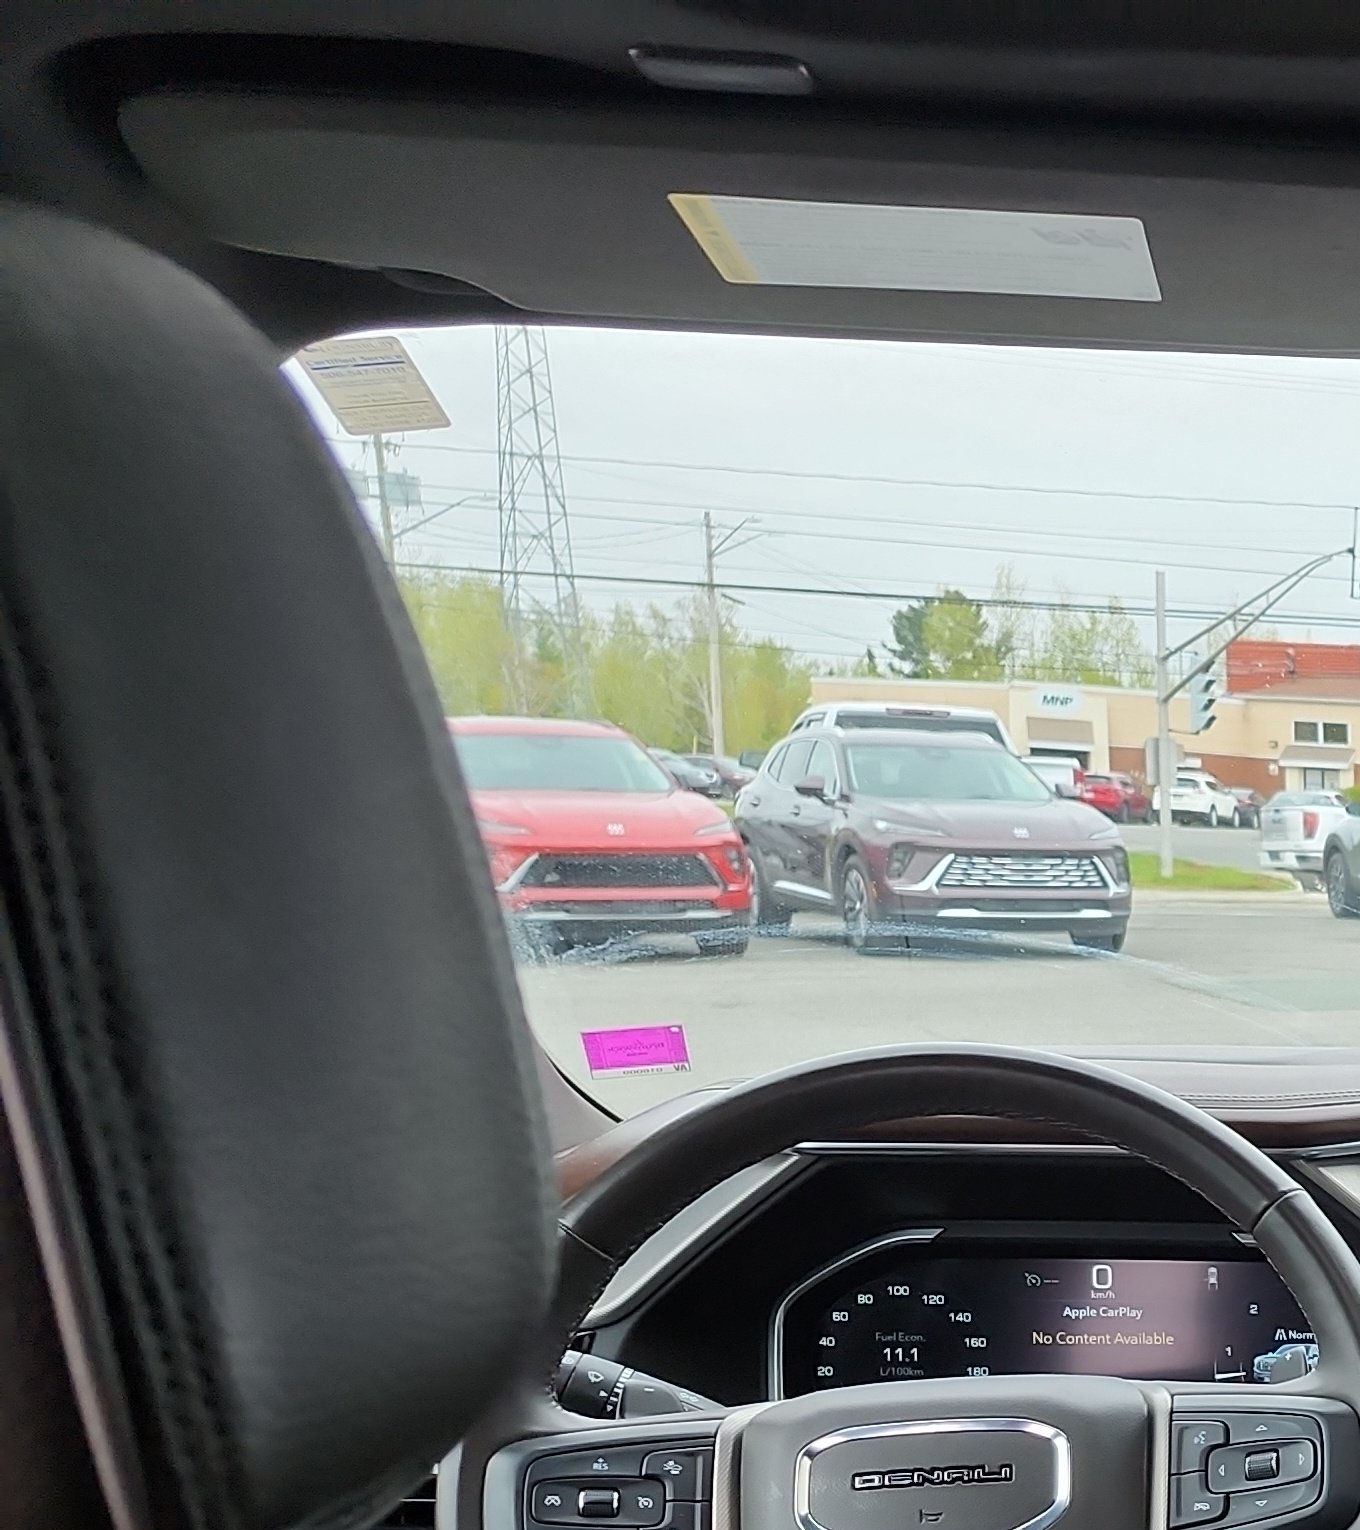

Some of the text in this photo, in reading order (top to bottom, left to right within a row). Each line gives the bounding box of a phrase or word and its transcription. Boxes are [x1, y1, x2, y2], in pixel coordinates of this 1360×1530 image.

[1041, 694, 1073, 707] MNP
[1092, 1264, 1112, 1289] 0
[887, 1286, 910, 1296] 100
[1091, 1290, 1116, 1299] km/h
[857, 1294, 874, 1304] 80
[922, 1294, 945, 1305] 120
[1063, 1306, 1143, 1320] Apple CarPlay
[1249, 1304, 1259, 1315] 2
[832, 1312, 849, 1322] 60
[949, 1312, 972, 1323] 140
[818, 1336, 836, 1347] 40
[876, 1332, 926, 1342] Fuel Econ.
[1032, 1332, 1175, 1345] No Content Available
[964, 1338, 987, 1348] 160
[883, 1348, 919, 1362] 11.1
[1225, 1346, 1232, 1356] 1
[817, 1366, 834, 1377] 20
[880, 1367, 924, 1377] L/100km
[966, 1366, 989, 1377] 180
[592, 1462, 608, 1470] RES
[852, 1463, 1015, 1491] DENALI
